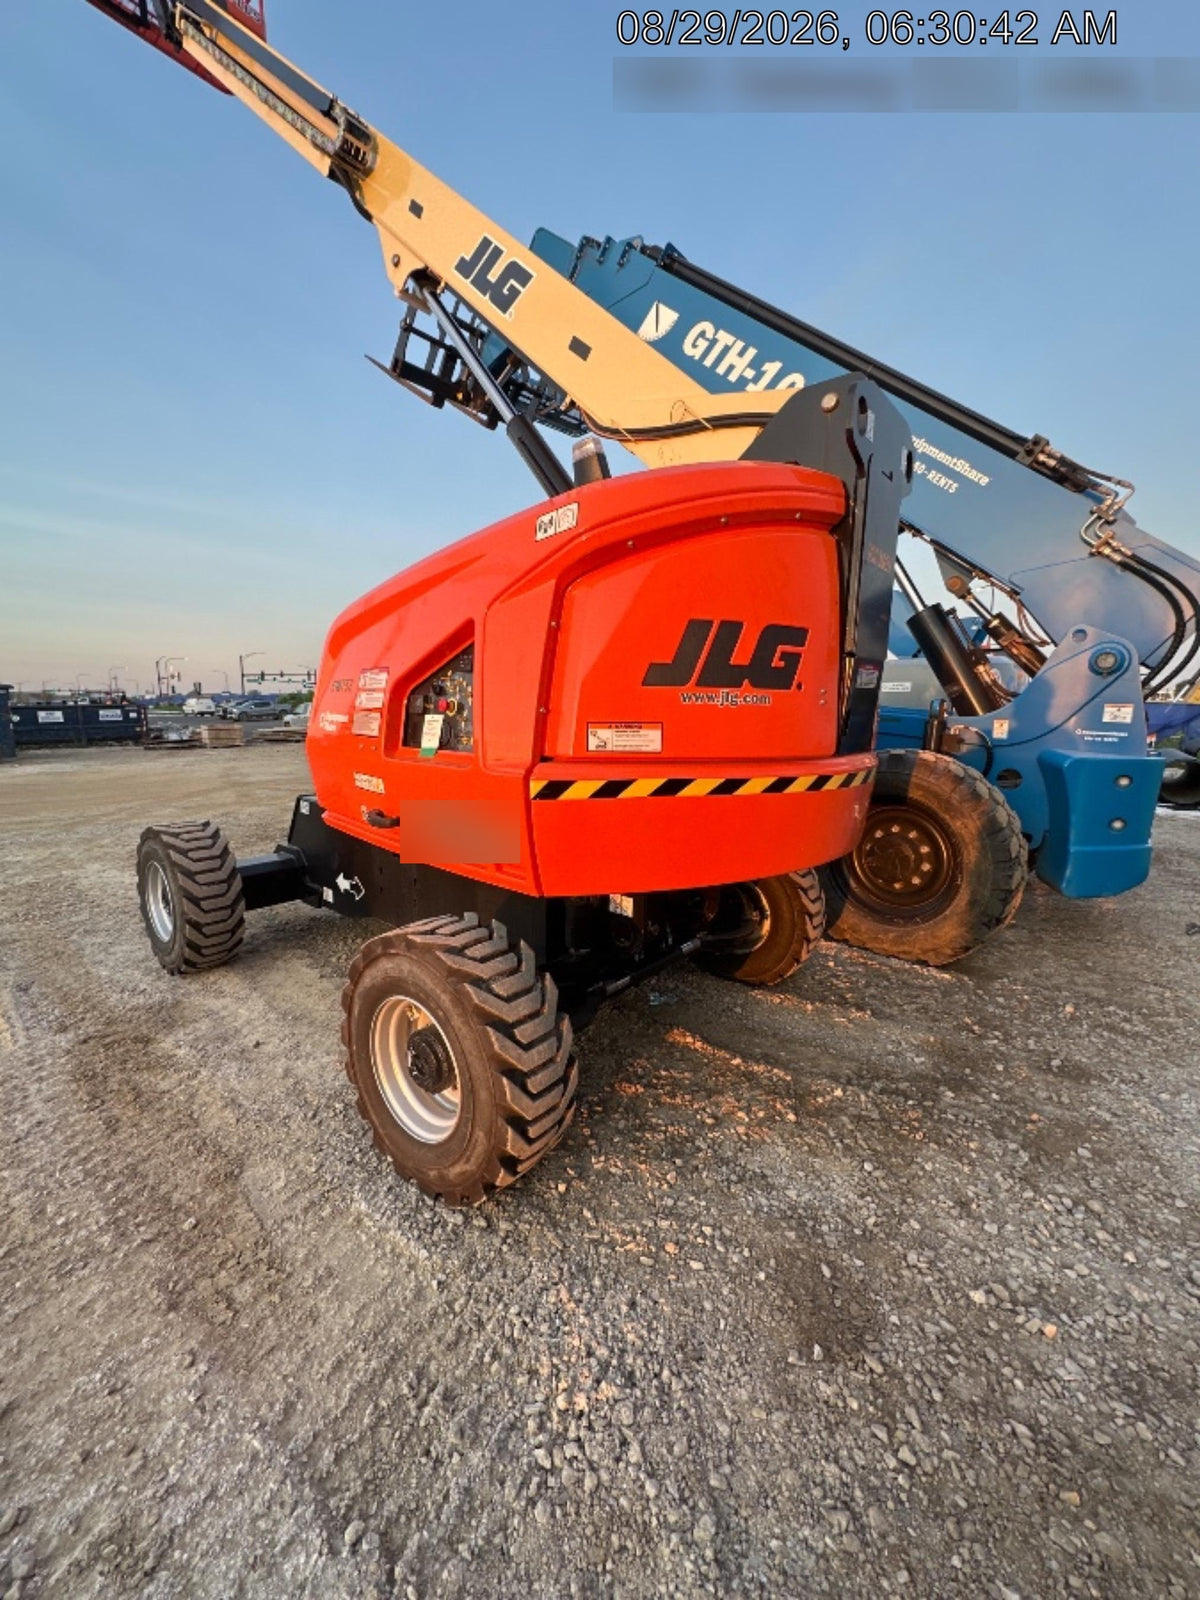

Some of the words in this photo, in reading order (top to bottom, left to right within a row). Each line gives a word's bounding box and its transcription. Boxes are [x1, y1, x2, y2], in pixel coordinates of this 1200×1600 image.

[452, 233, 537, 318] JLG
[641, 618, 810, 691] JLG
[680, 689, 772, 707] www.jlg.com
